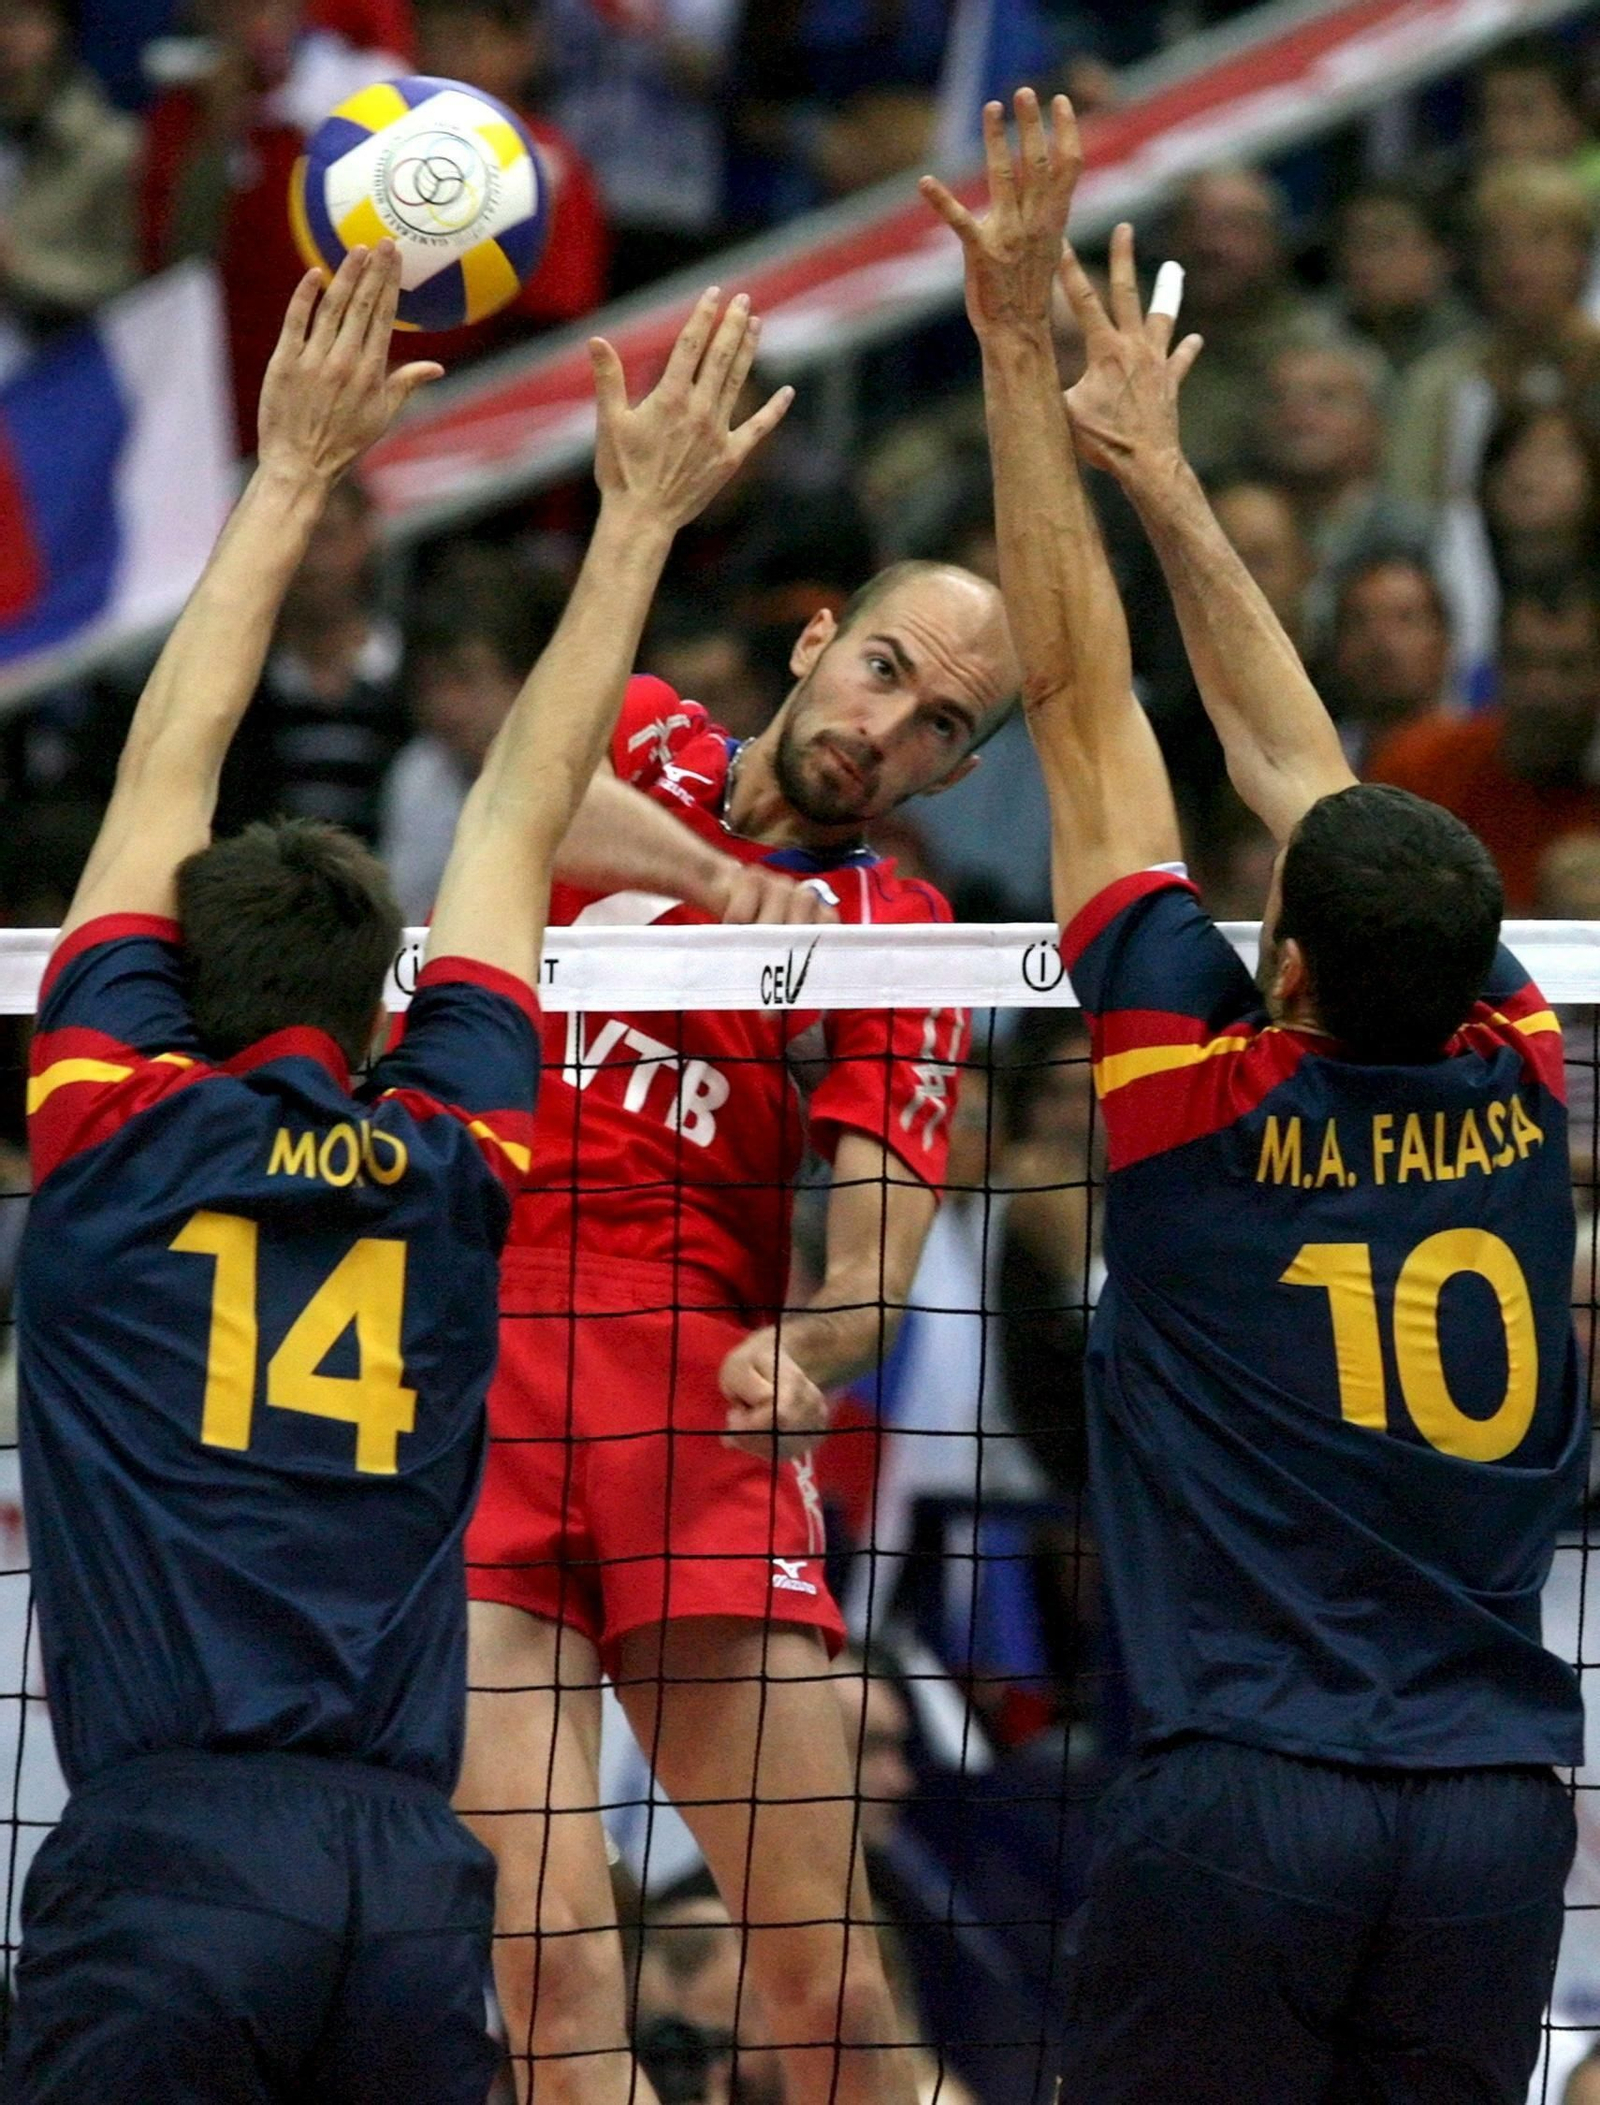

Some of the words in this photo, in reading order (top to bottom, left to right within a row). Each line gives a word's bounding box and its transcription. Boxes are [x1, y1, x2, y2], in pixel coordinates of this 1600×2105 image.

[761, 934, 822, 1005] CEV
[562, 1010, 730, 1148] VTB
[1256, 1115, 1358, 1190] M.A.
[168, 1209, 419, 1476] 14
[1277, 1227, 1539, 1463] 10
